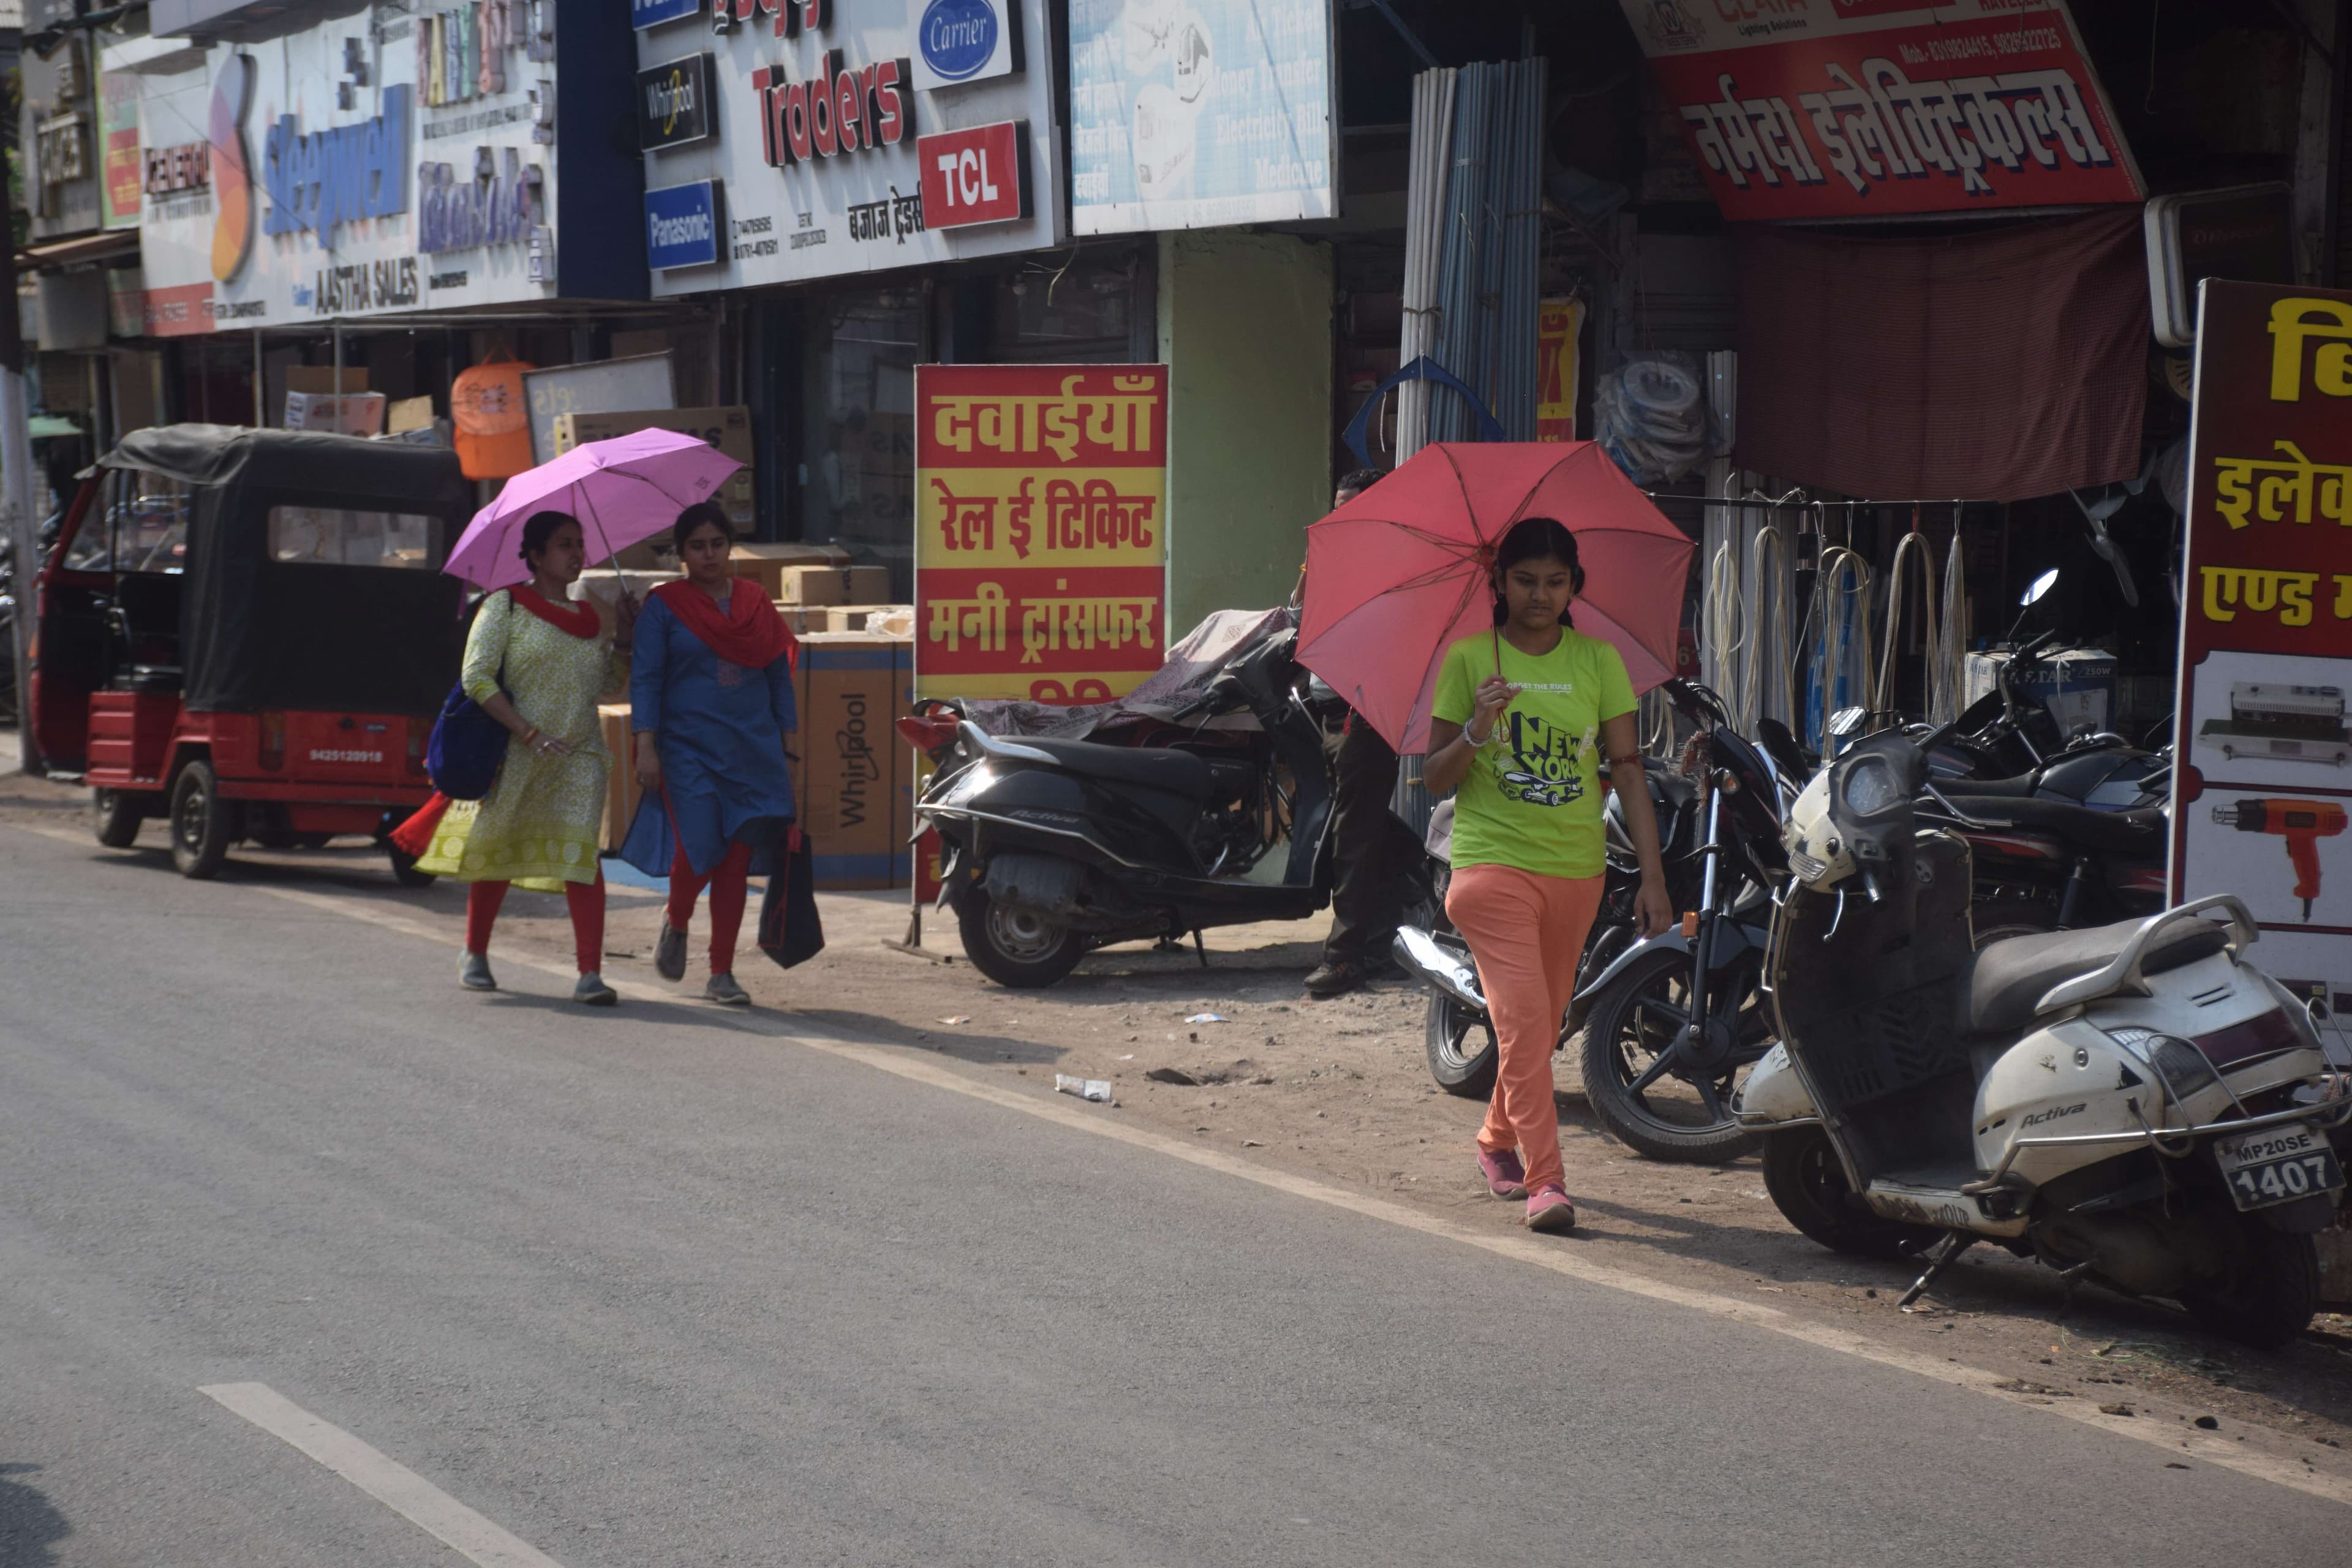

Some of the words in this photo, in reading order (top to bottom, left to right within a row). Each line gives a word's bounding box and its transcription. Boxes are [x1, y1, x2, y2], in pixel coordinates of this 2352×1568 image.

[930, 11, 987, 53] Carrier
[1738, 23, 1771, 37] Lighting
[1770, 18, 1806, 32] Solutions
[753, 50, 903, 167] Traders
[1680, 74, 1823, 185] नर्मदा
[263, 83, 407, 249] Sleepwell
[938, 148, 998, 206] TCL
[650, 202, 711, 248] Panasonic
[848, 200, 890, 243] बजाज
[316, 263, 371, 315] AASTHA
[374, 255, 419, 307] SALES
[931, 375, 1158, 462] दवाईयाँ
[931, 478, 998, 551] रेल
[1007, 477, 1035, 560] ई
[1045, 478, 1156, 549] टिकिट
[927, 581, 1011, 652] मनी
[1020, 578, 1158, 664] ट्रांसफर
[2199, 567, 2320, 627] एण्ड
[2085, 666, 2111, 675] 250W
[840, 693, 880, 828] Whirlpool
[1511, 710, 1582, 761] NEW
[1514, 753, 1581, 783] YORK
[1006, 807, 1081, 825] Activa
[2021, 1102, 2087, 1129] Activa
[2237, 1134, 2312, 1163] MP20SE
[2236, 1155, 2327, 1201] 1407
